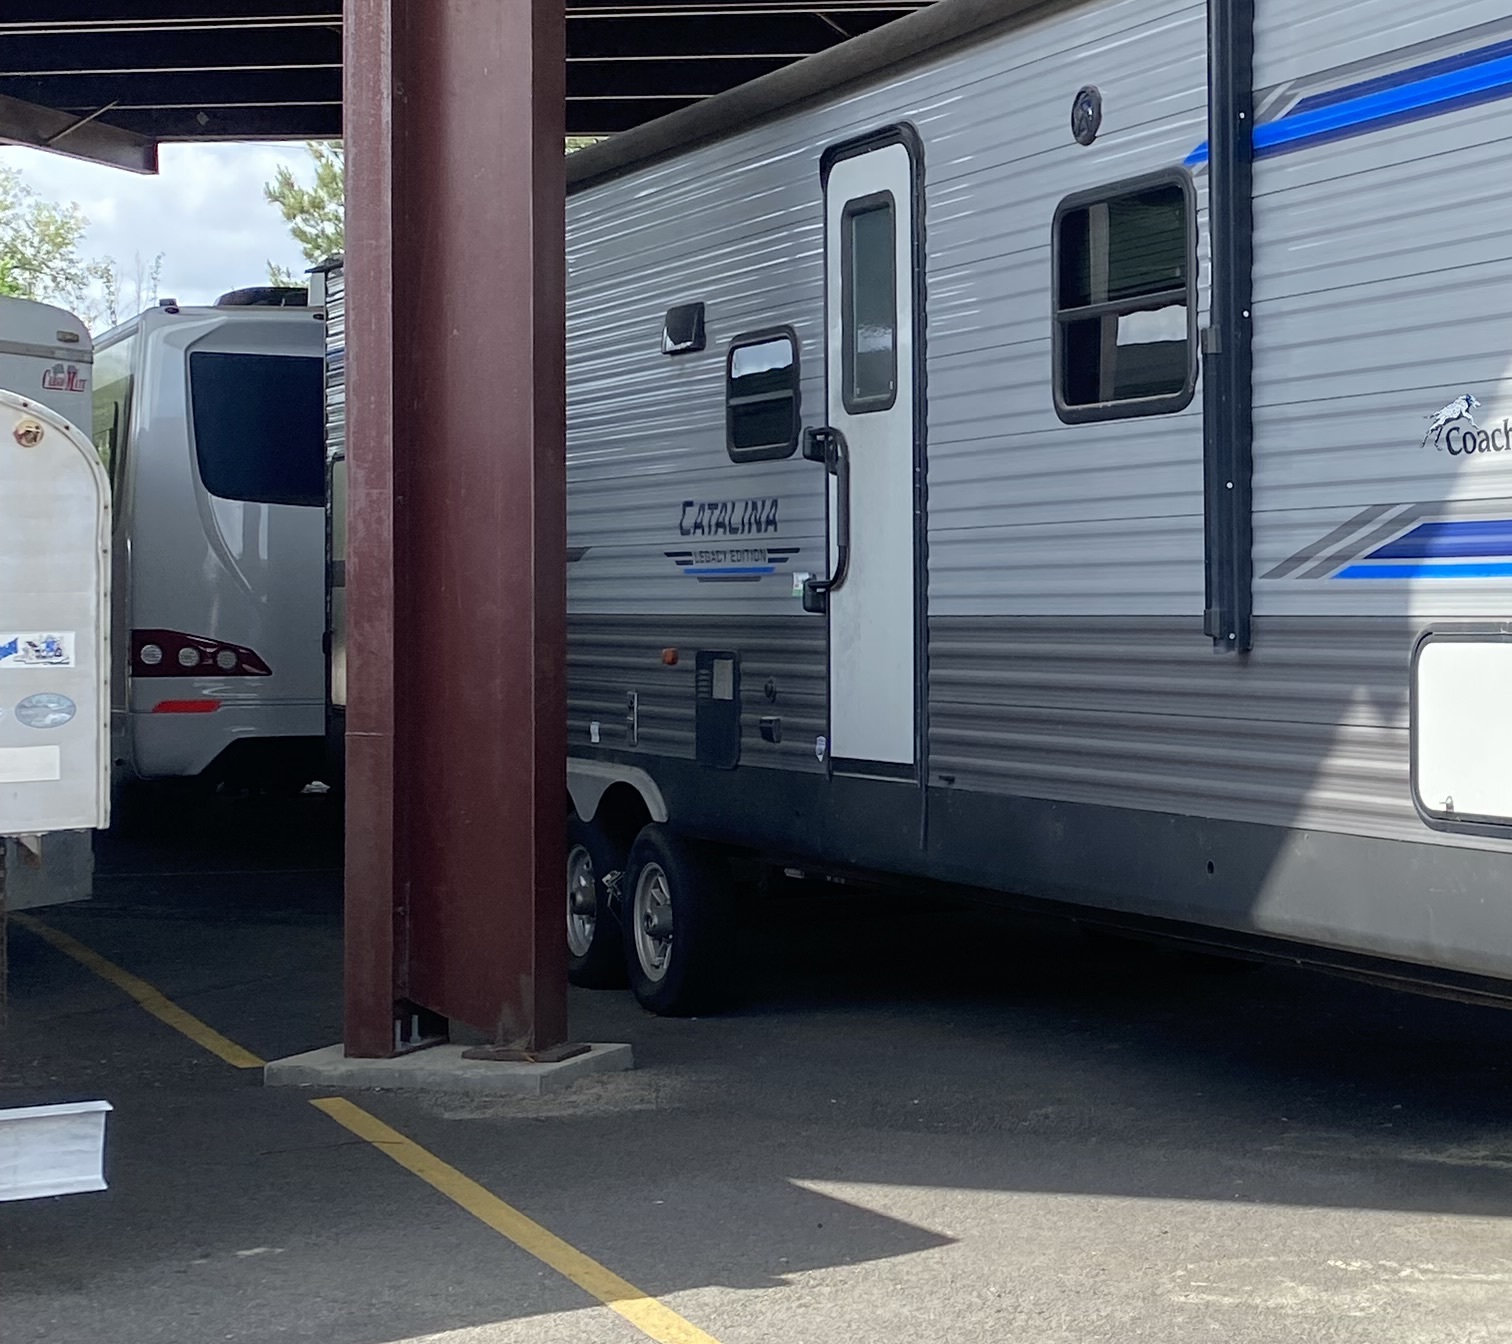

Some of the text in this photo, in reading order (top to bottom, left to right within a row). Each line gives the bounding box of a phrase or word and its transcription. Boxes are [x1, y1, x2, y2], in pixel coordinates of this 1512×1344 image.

[679, 499, 779, 536] CATALINA
[694, 549, 767, 564] LEGACY EDITION
